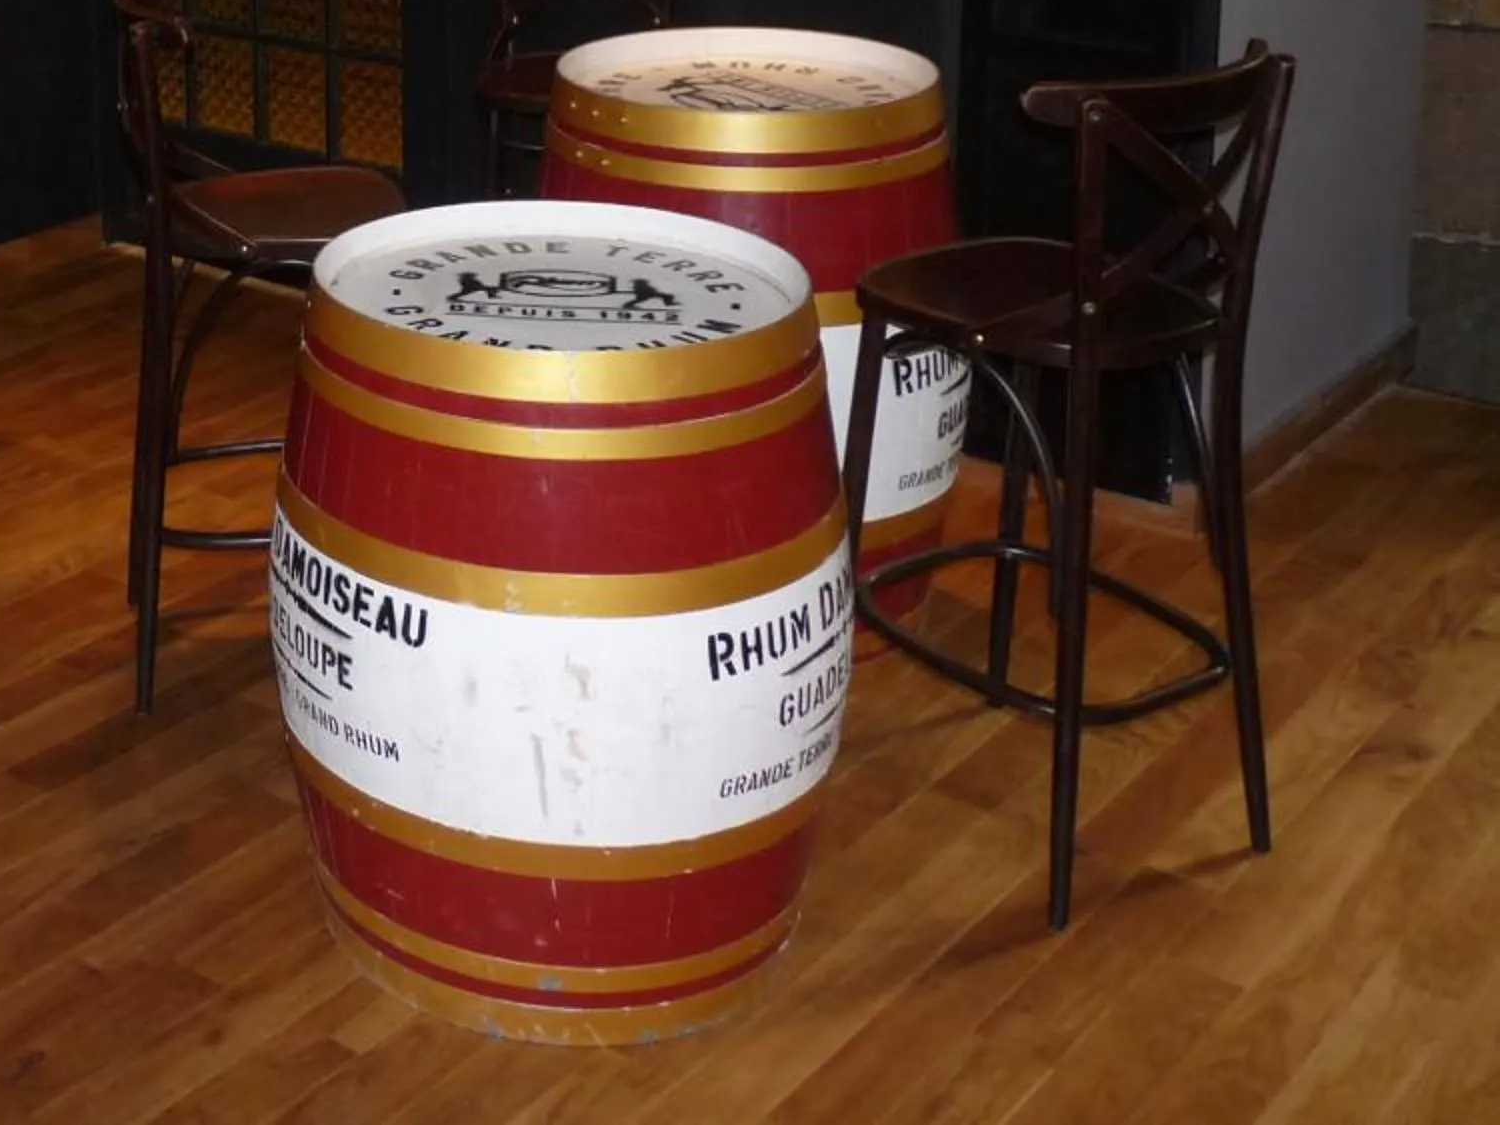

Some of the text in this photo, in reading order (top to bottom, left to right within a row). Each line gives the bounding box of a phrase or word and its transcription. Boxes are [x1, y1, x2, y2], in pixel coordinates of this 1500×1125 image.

[389, 241, 745, 294] GRANDE TERRE
[448, 303, 681, 322] DEPUIS 1942
[707, 603, 811, 682] RHUM
[342, 722, 401, 763] RHUM
[719, 756, 795, 799] GRANDE
